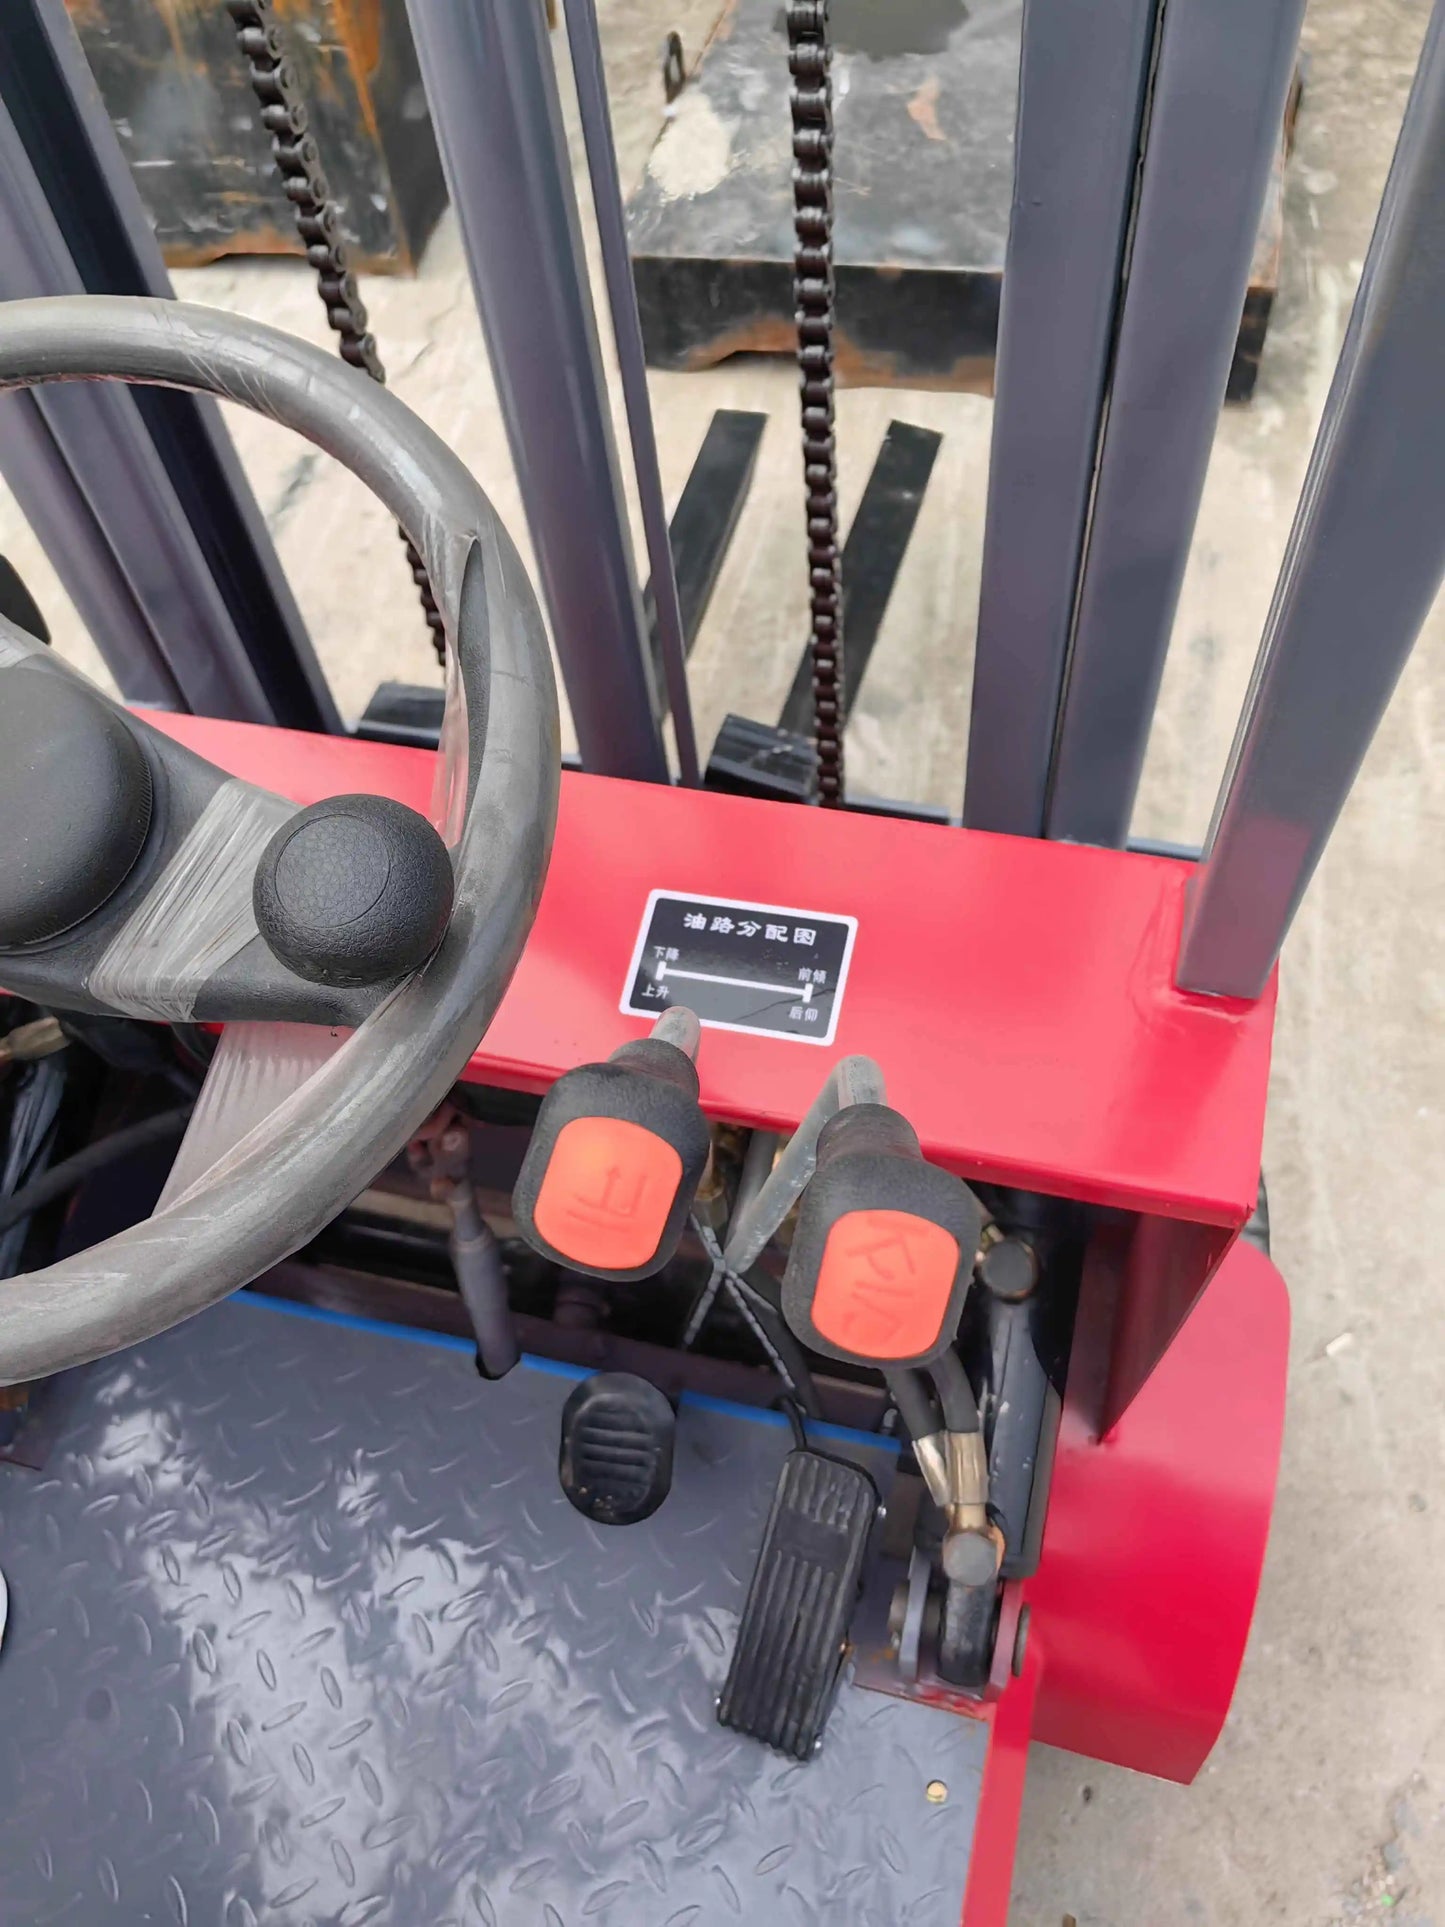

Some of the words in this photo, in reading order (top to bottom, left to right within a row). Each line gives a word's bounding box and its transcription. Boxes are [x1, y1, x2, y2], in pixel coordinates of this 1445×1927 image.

[683, 912, 817, 946] 油路分配图
[653, 945, 680, 961] 下降
[641, 984, 670, 999] 上升
[788, 1006, 819, 1022] 后仰
